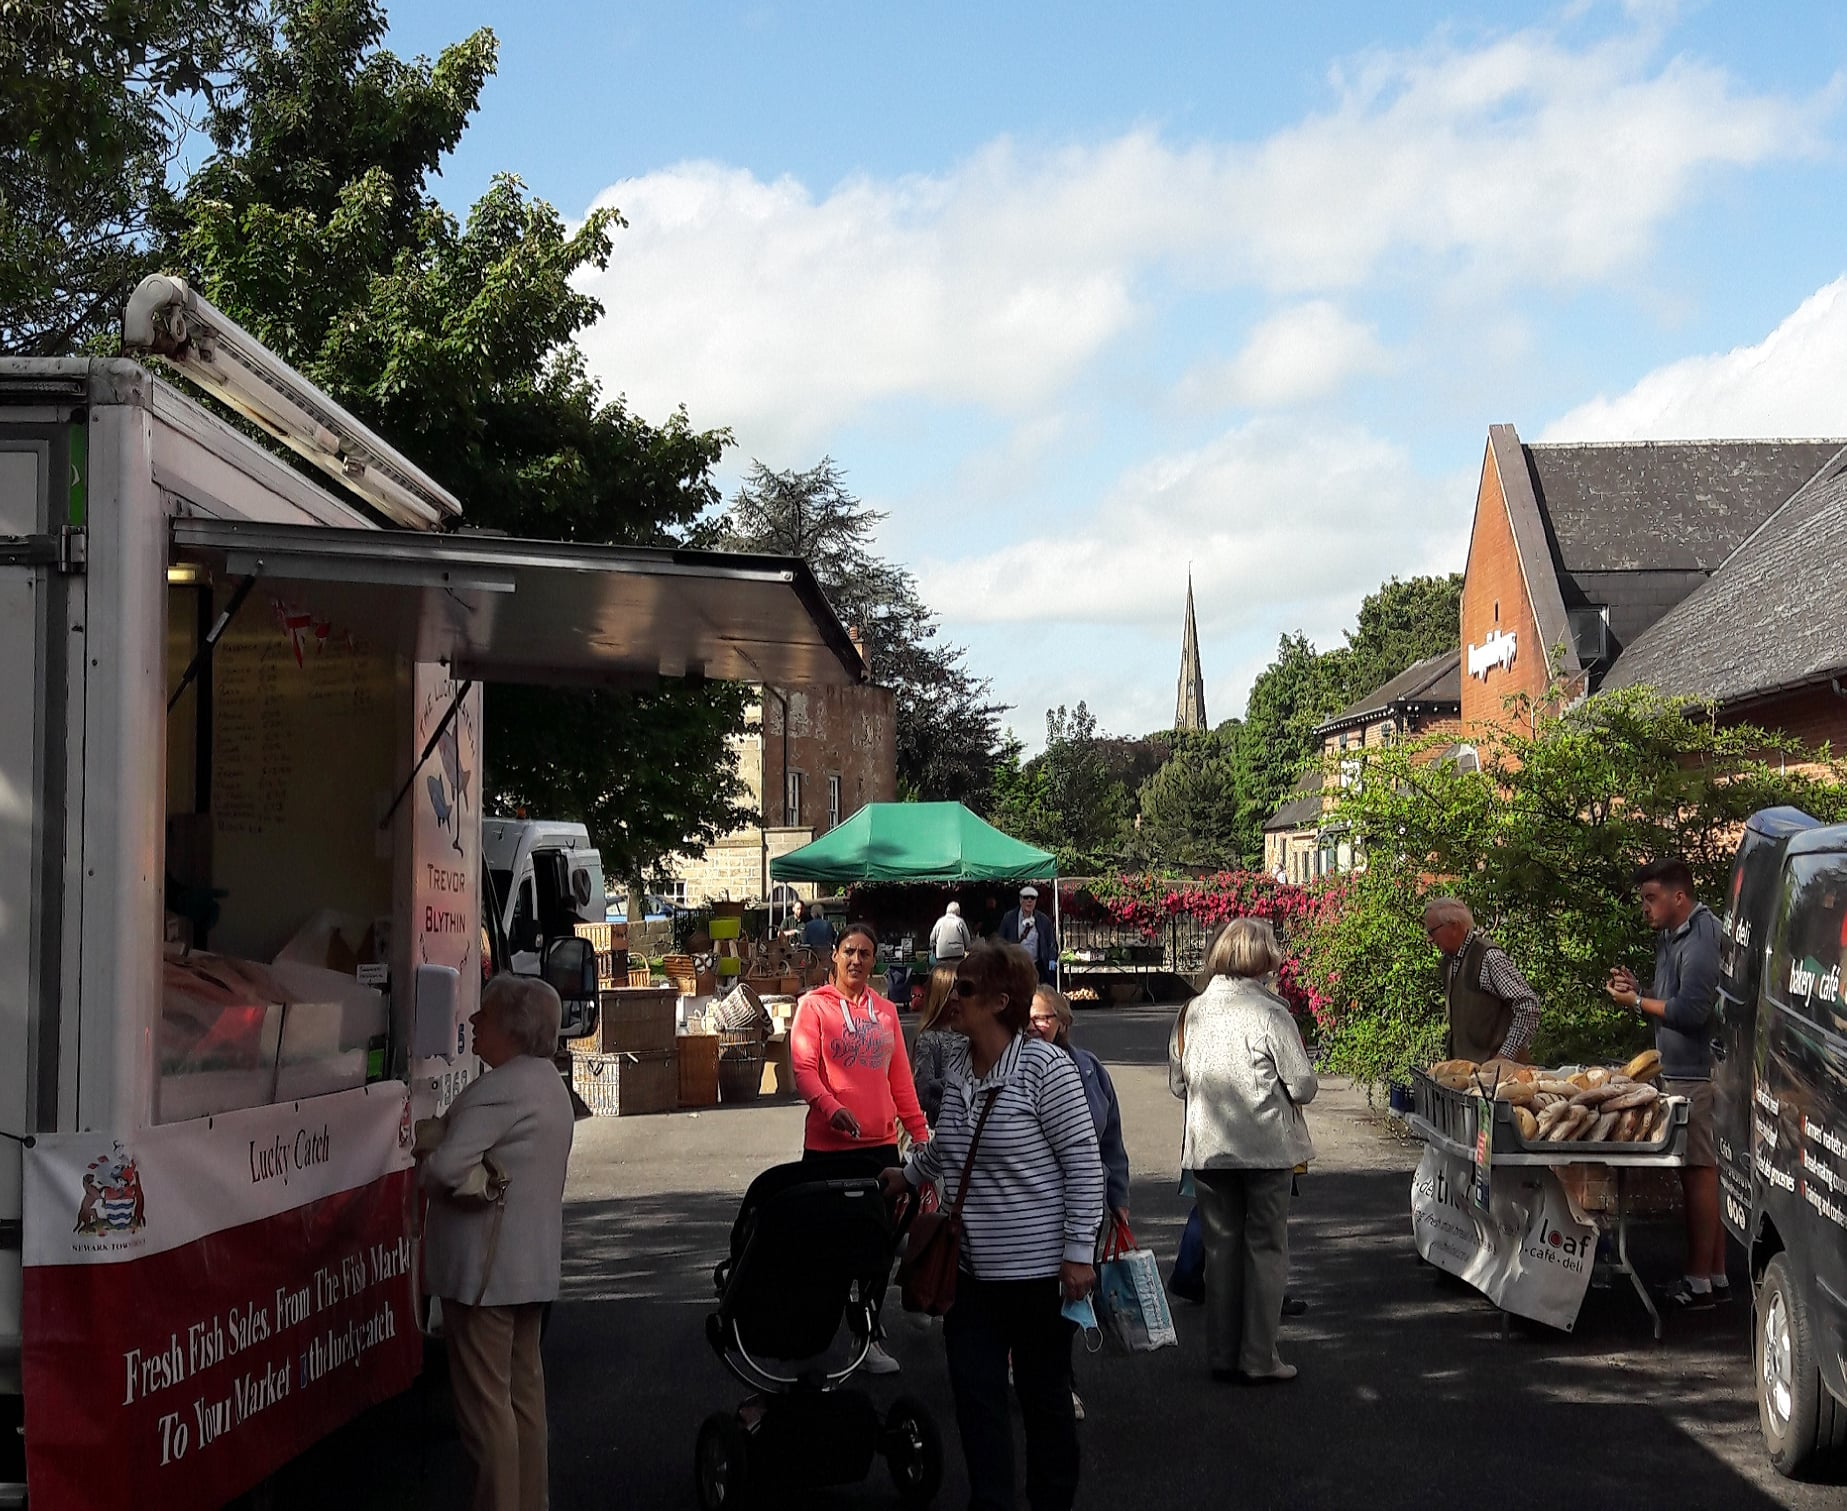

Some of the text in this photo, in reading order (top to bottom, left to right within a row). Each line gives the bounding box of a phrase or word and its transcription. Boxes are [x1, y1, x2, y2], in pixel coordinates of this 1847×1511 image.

[427, 863, 466, 893] TREVOR
[425, 905, 467, 933] BLYTHIN
[1735, 916, 1752, 949] deli
[1788, 957, 1817, 1008] bakery
[1818, 963, 1841, 1003] café
[249, 1124, 330, 1186] Lucky Catch
[1539, 1217, 1592, 1259] loaf
[1529, 1246, 1584, 1274] café deli
[121, 1333, 185, 1406] Fresh
[187, 1315, 225, 1377] Fish
[275, 1286, 311, 1334] From
[314, 1266, 340, 1313] The
[341, 1251, 367, 1300] Fish
[157, 1411, 189, 1467] To
[193, 1396, 233, 1450] Your
[234, 1354, 292, 1425] Market
